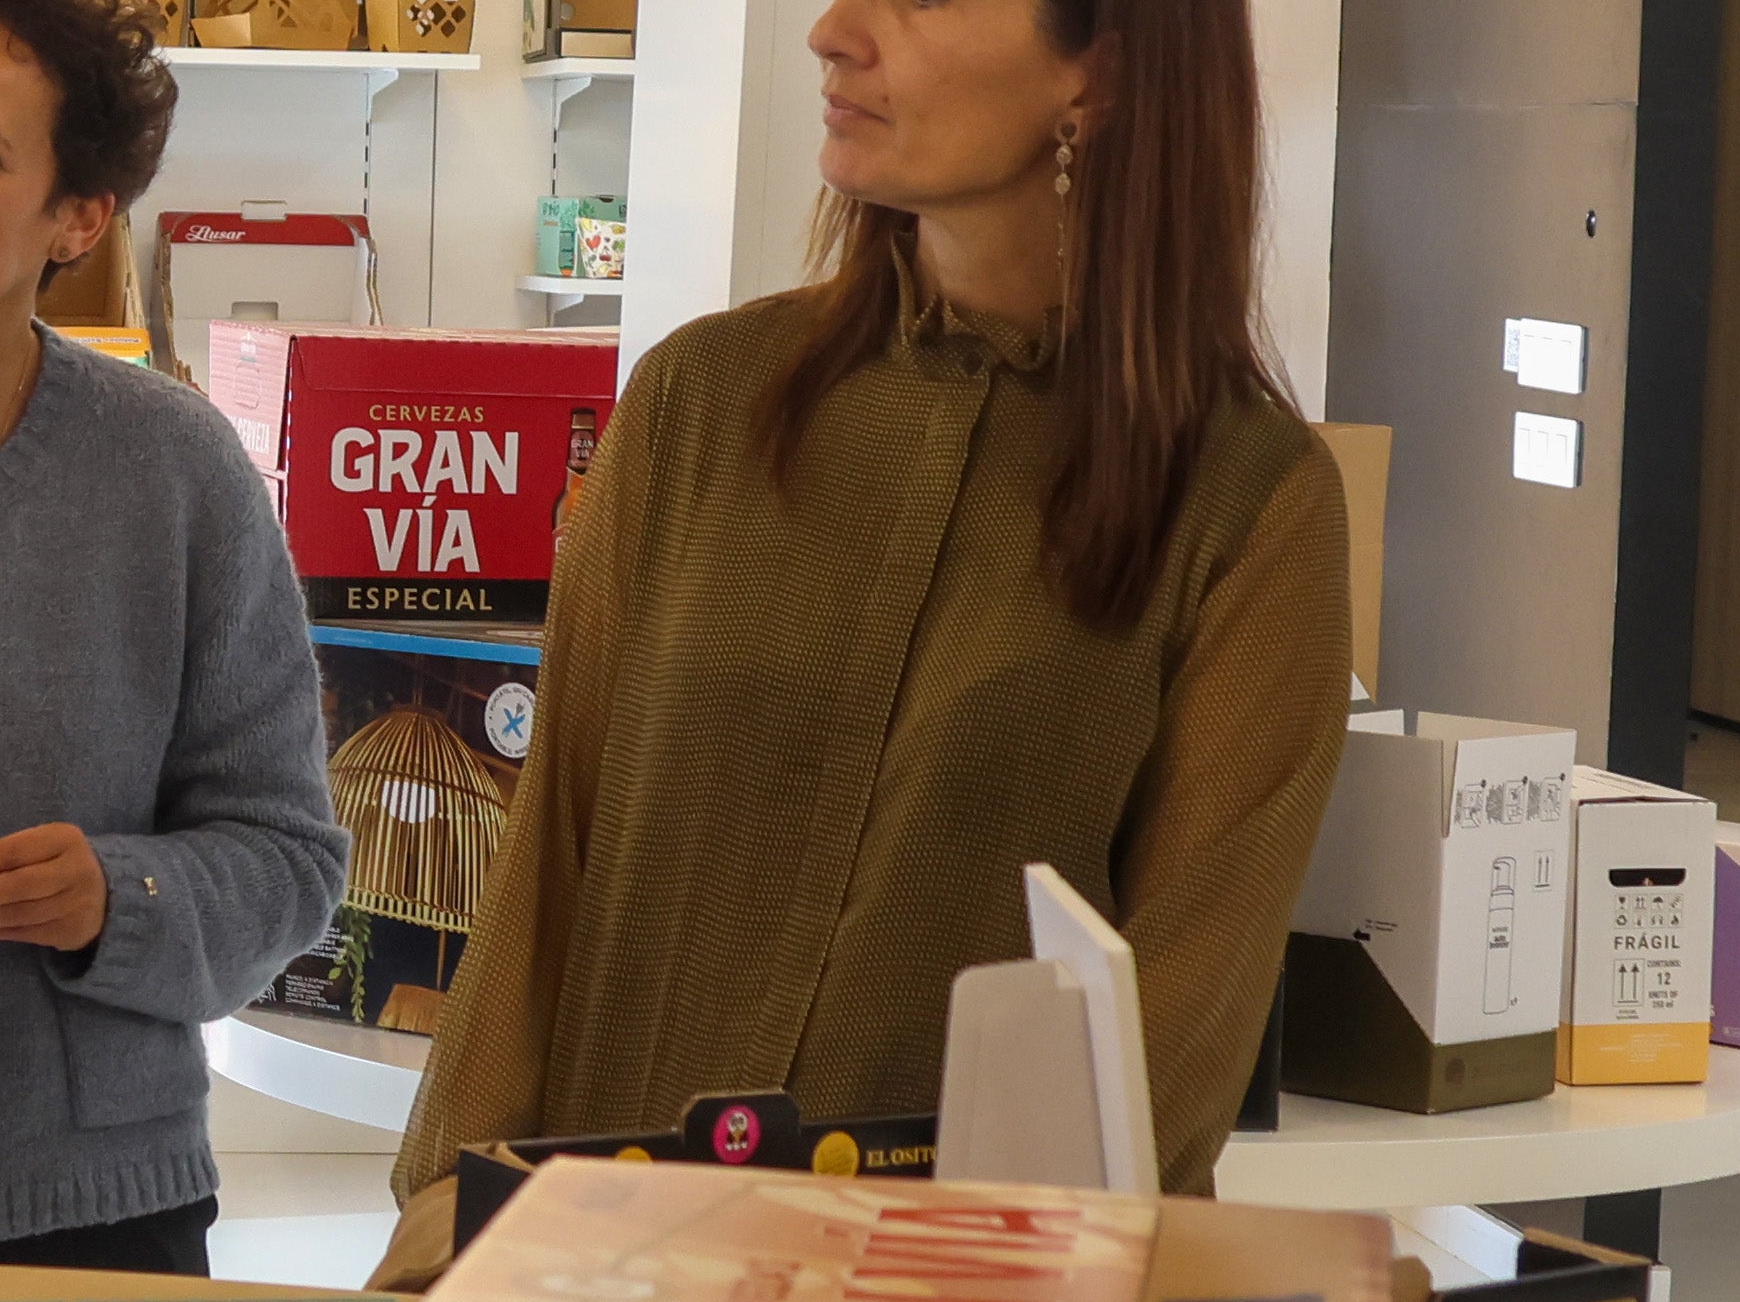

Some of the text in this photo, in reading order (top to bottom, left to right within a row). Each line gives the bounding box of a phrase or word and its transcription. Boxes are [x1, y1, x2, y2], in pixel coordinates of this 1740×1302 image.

[186, 225, 246, 242] Llusar
[369, 404, 485, 423] CERVEZAS
[330, 426, 519, 495] GRAN
[363, 495, 481, 573] VÍA
[347, 587, 493, 611] ESPECIAL
[1614, 932, 1681, 950] FRÁGIL
[1657, 972, 1671, 985] 12
